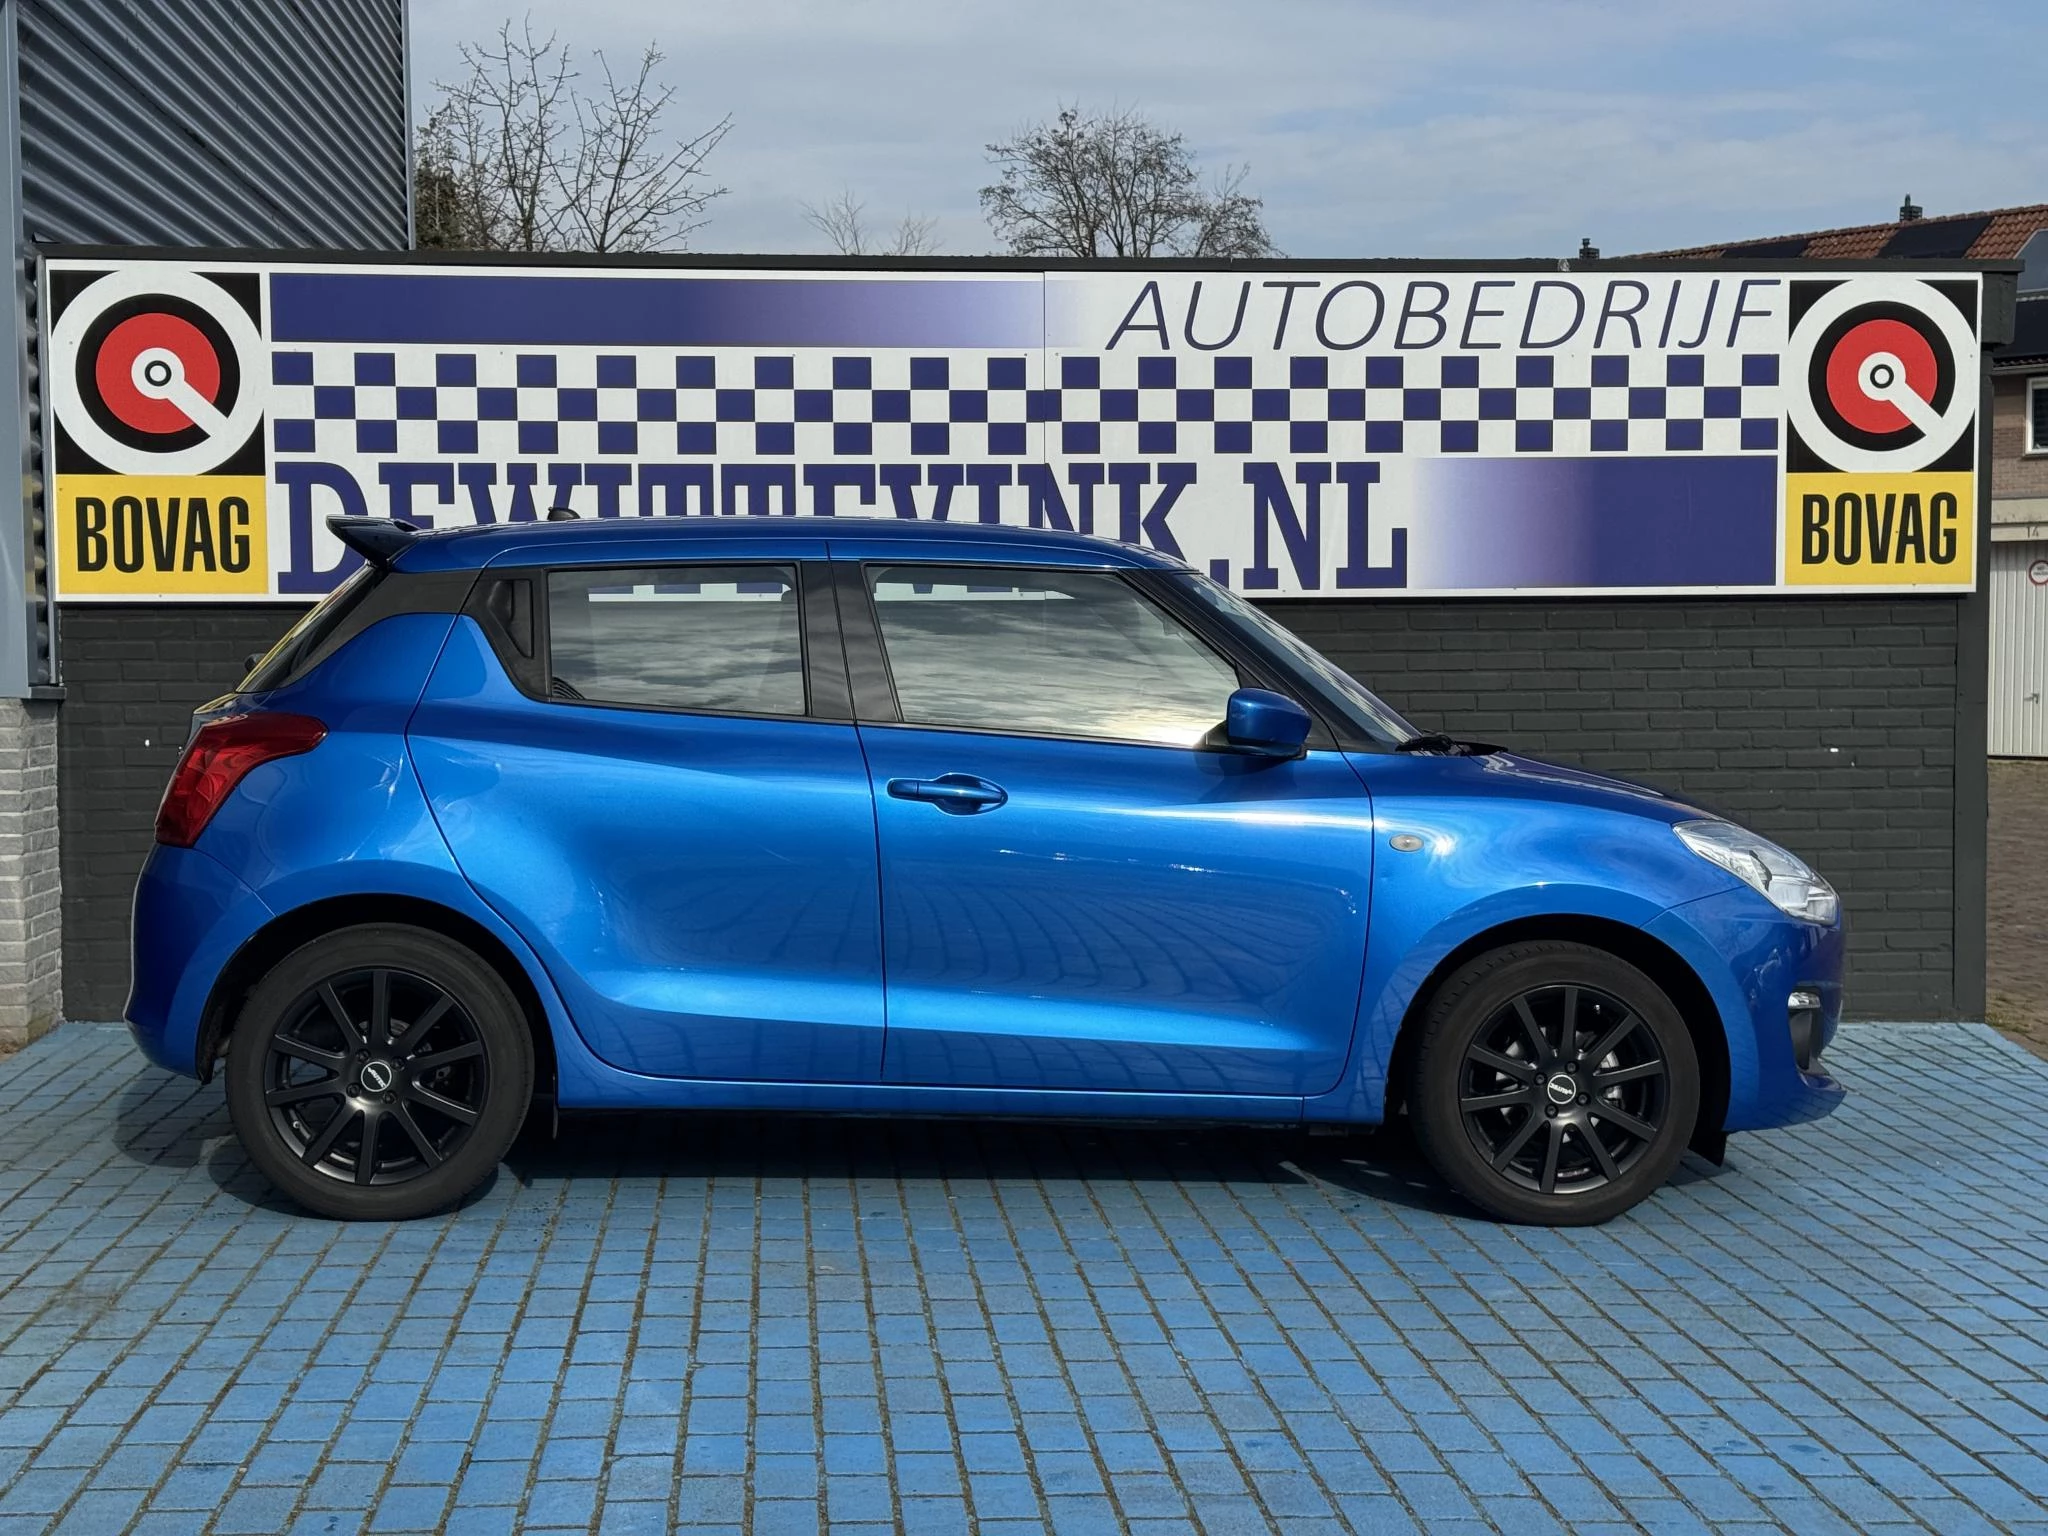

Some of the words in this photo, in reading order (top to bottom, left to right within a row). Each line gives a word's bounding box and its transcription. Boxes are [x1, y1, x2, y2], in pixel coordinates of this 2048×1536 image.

[1105, 279, 1781, 351] AUTOBEDRIJF
[75, 495, 251, 573] BOVAG
[1801, 491, 1958, 565] BOVAG
